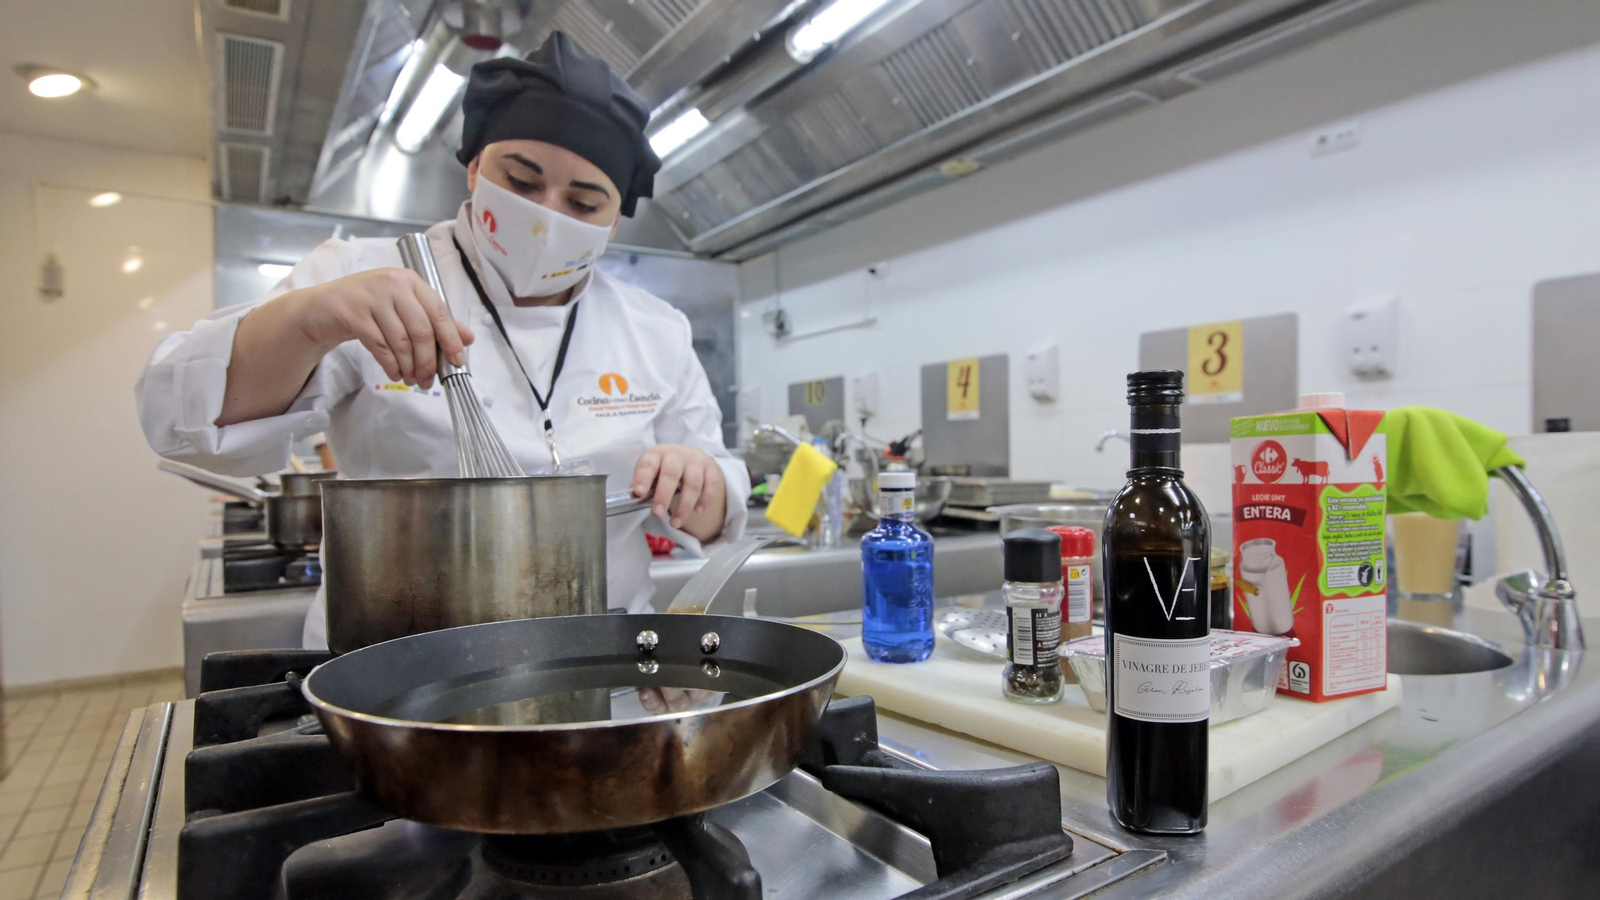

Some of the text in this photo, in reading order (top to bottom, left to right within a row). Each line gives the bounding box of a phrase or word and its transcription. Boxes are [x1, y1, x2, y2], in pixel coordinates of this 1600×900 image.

[1201, 331, 1228, 376] 3
[957, 365, 971, 398] 4
[806, 381, 825, 403] 10
[577, 396, 609, 406] Cocina
[1256, 419, 1279, 432] NUEVO
[1253, 460, 1284, 475] Classic
[1271, 494, 1286, 502] UHT
[1243, 506, 1291, 521] ENTERA
[1122, 659, 1169, 674] VINAGRE
[1172, 664, 1187, 673] DE
